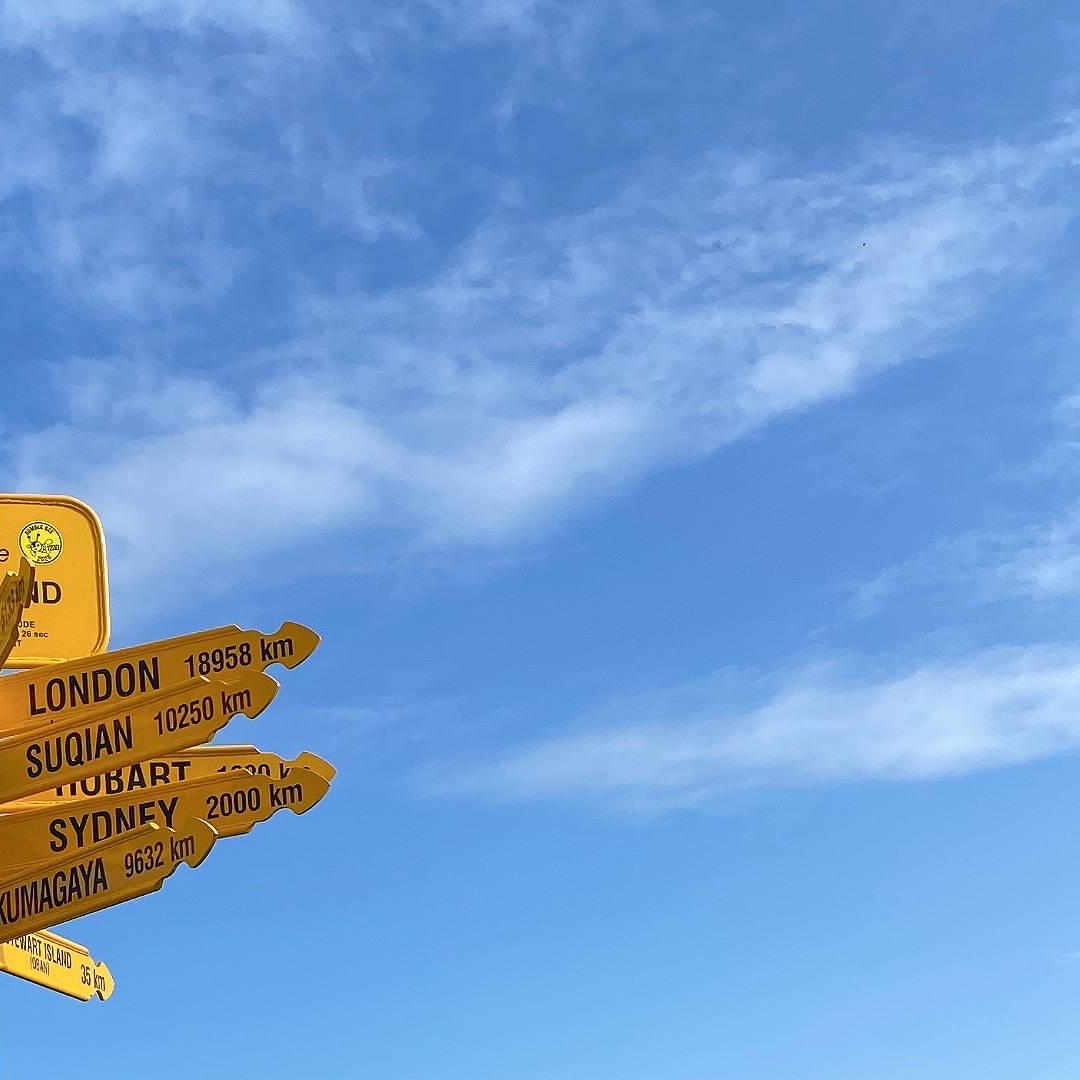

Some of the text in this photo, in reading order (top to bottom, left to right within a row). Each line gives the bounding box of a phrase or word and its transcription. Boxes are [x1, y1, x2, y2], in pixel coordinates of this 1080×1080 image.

[28, 635, 294, 716] LONDON 18958 km
[26, 687, 252, 779] SUQIAN 10250 km
[49, 783, 303, 853] SYDNEY 2000 km
[124, 841, 165, 879] 9632
[170, 834, 195, 863] km
[7, 935, 106, 992] EWART ISLAND 35 km
[29, 955, 50, 976] (OBAN)
